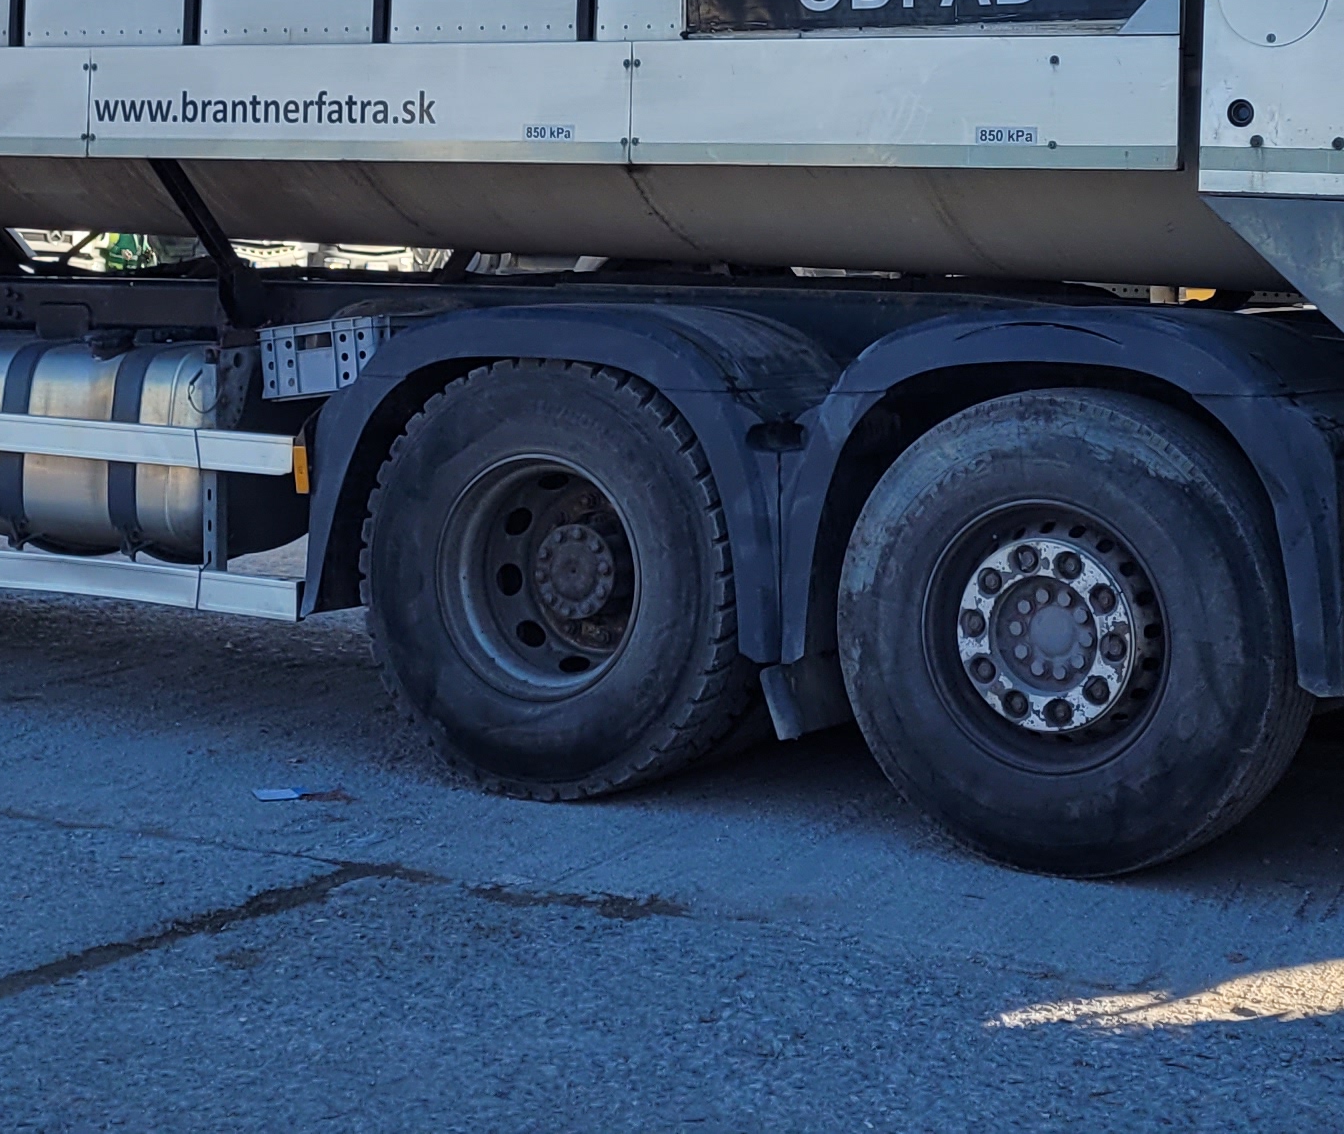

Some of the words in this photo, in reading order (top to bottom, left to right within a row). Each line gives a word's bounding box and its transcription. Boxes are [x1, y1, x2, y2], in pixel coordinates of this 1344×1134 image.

[94, 90, 437, 124] www.brantnerfatra.sk
[526, 126, 546, 139] 850
[549, 126, 571, 139] kPa
[979, 129, 1004, 142] 850
[1007, 129, 1033, 143] kPa
